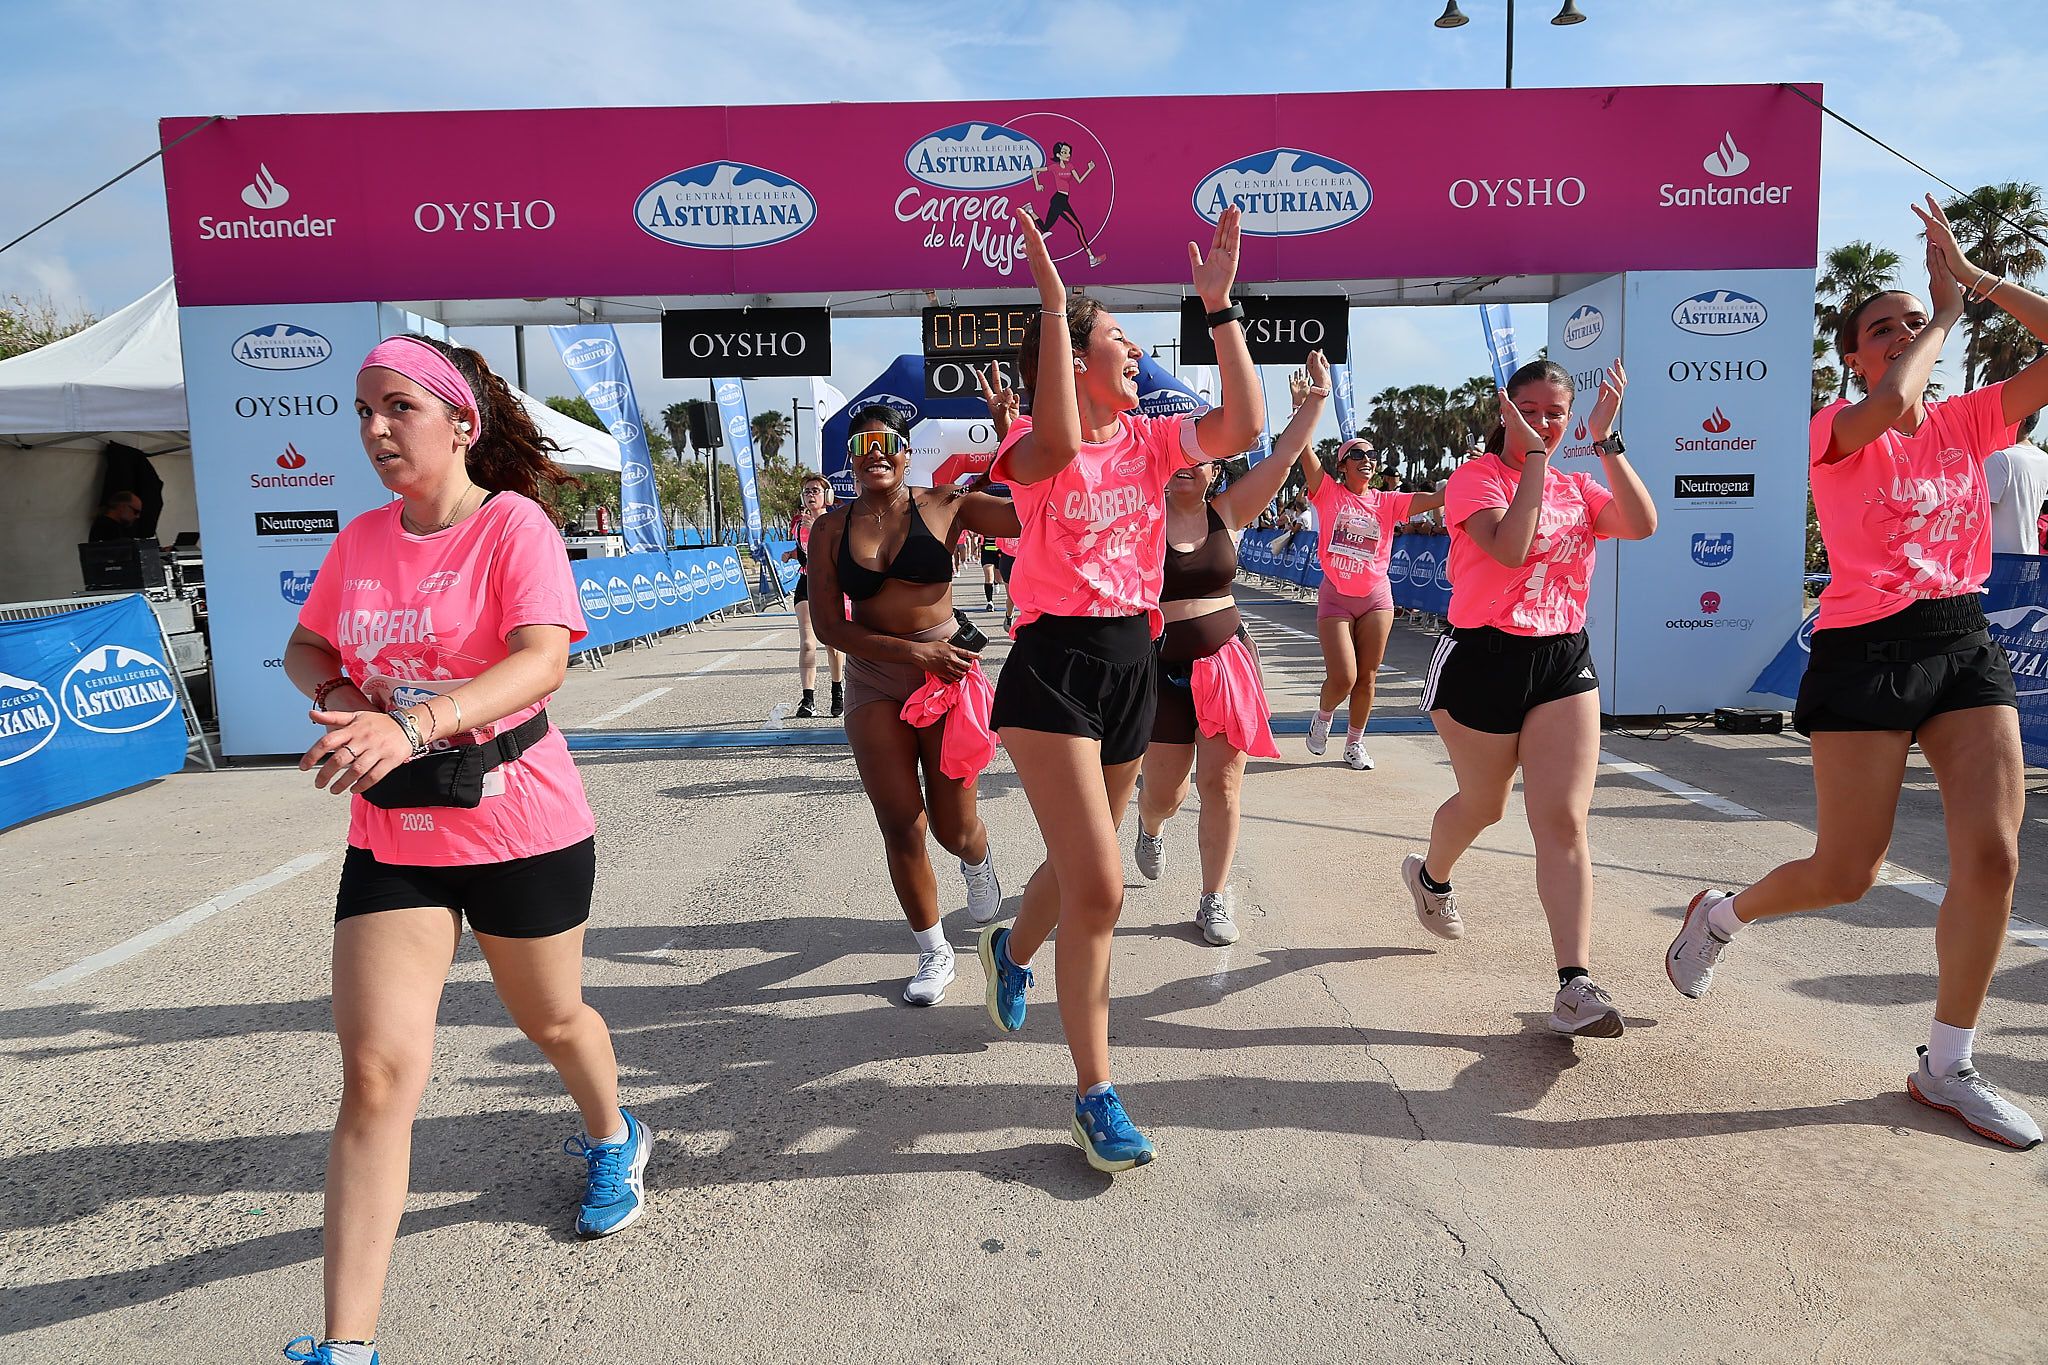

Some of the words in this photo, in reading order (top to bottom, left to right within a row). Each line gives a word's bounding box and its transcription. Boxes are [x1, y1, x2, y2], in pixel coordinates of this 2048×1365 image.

[937, 145, 981, 153] CENTRAL
[985, 144, 1030, 152] LECHERA
[916, 148, 1034, 173] ASTURIANA
[1234, 178, 1291, 188] CENTRAL
[1296, 178, 1353, 187] LECHERA
[1448, 177, 1586, 208] OYSHO
[1659, 181, 1792, 207] Santander
[676, 191, 732, 201] CENTRAL
[738, 191, 796, 200] LECHERA
[894, 187, 1010, 222] Carrera
[1207, 183, 1358, 214] ASTURIANA
[414, 200, 556, 232] OYSHO
[649, 195, 803, 227] ASTURIANA
[199, 214, 336, 239] Santander
[923, 225, 945, 247] de
[949, 223, 965, 247] la
[1679, 307, 1760, 324] ASTURIANA
[1209, 319, 1324, 344] YSHO
[1566, 321, 1601, 343] ASTURIANA
[240, 342, 325, 359] ASTURIANA
[689, 332, 806, 358] OYSHO
[1571, 367, 1604, 391] YSHO
[1669, 359, 1768, 382] OYSHO
[235, 394, 339, 418] OYSHO
[1136, 402, 1195, 414] ASTURIANA
[1563, 444, 1595, 459] Santande
[1675, 436, 1757, 452] Santander
[250, 472, 336, 489] Santander
[1680, 479, 1749, 495] Neutrogena
[1064, 483, 1147, 521] CARRERA
[261, 516, 333, 532] Neutrogena
[1346, 533, 1365, 543] 016
[1693, 540, 1732, 559] Marlene
[1330, 555, 1365, 574] MUJER
[338, 606, 437, 646] ARRERA
[1665, 618, 1714, 631] octopus
[1714, 618, 1755, 631] energy
[85, 674, 124, 689] CENTRAL
[124, 668, 160, 682] LECHERA
[74, 679, 172, 720] ASTURIANA
[400, 813, 436, 832] 2026
